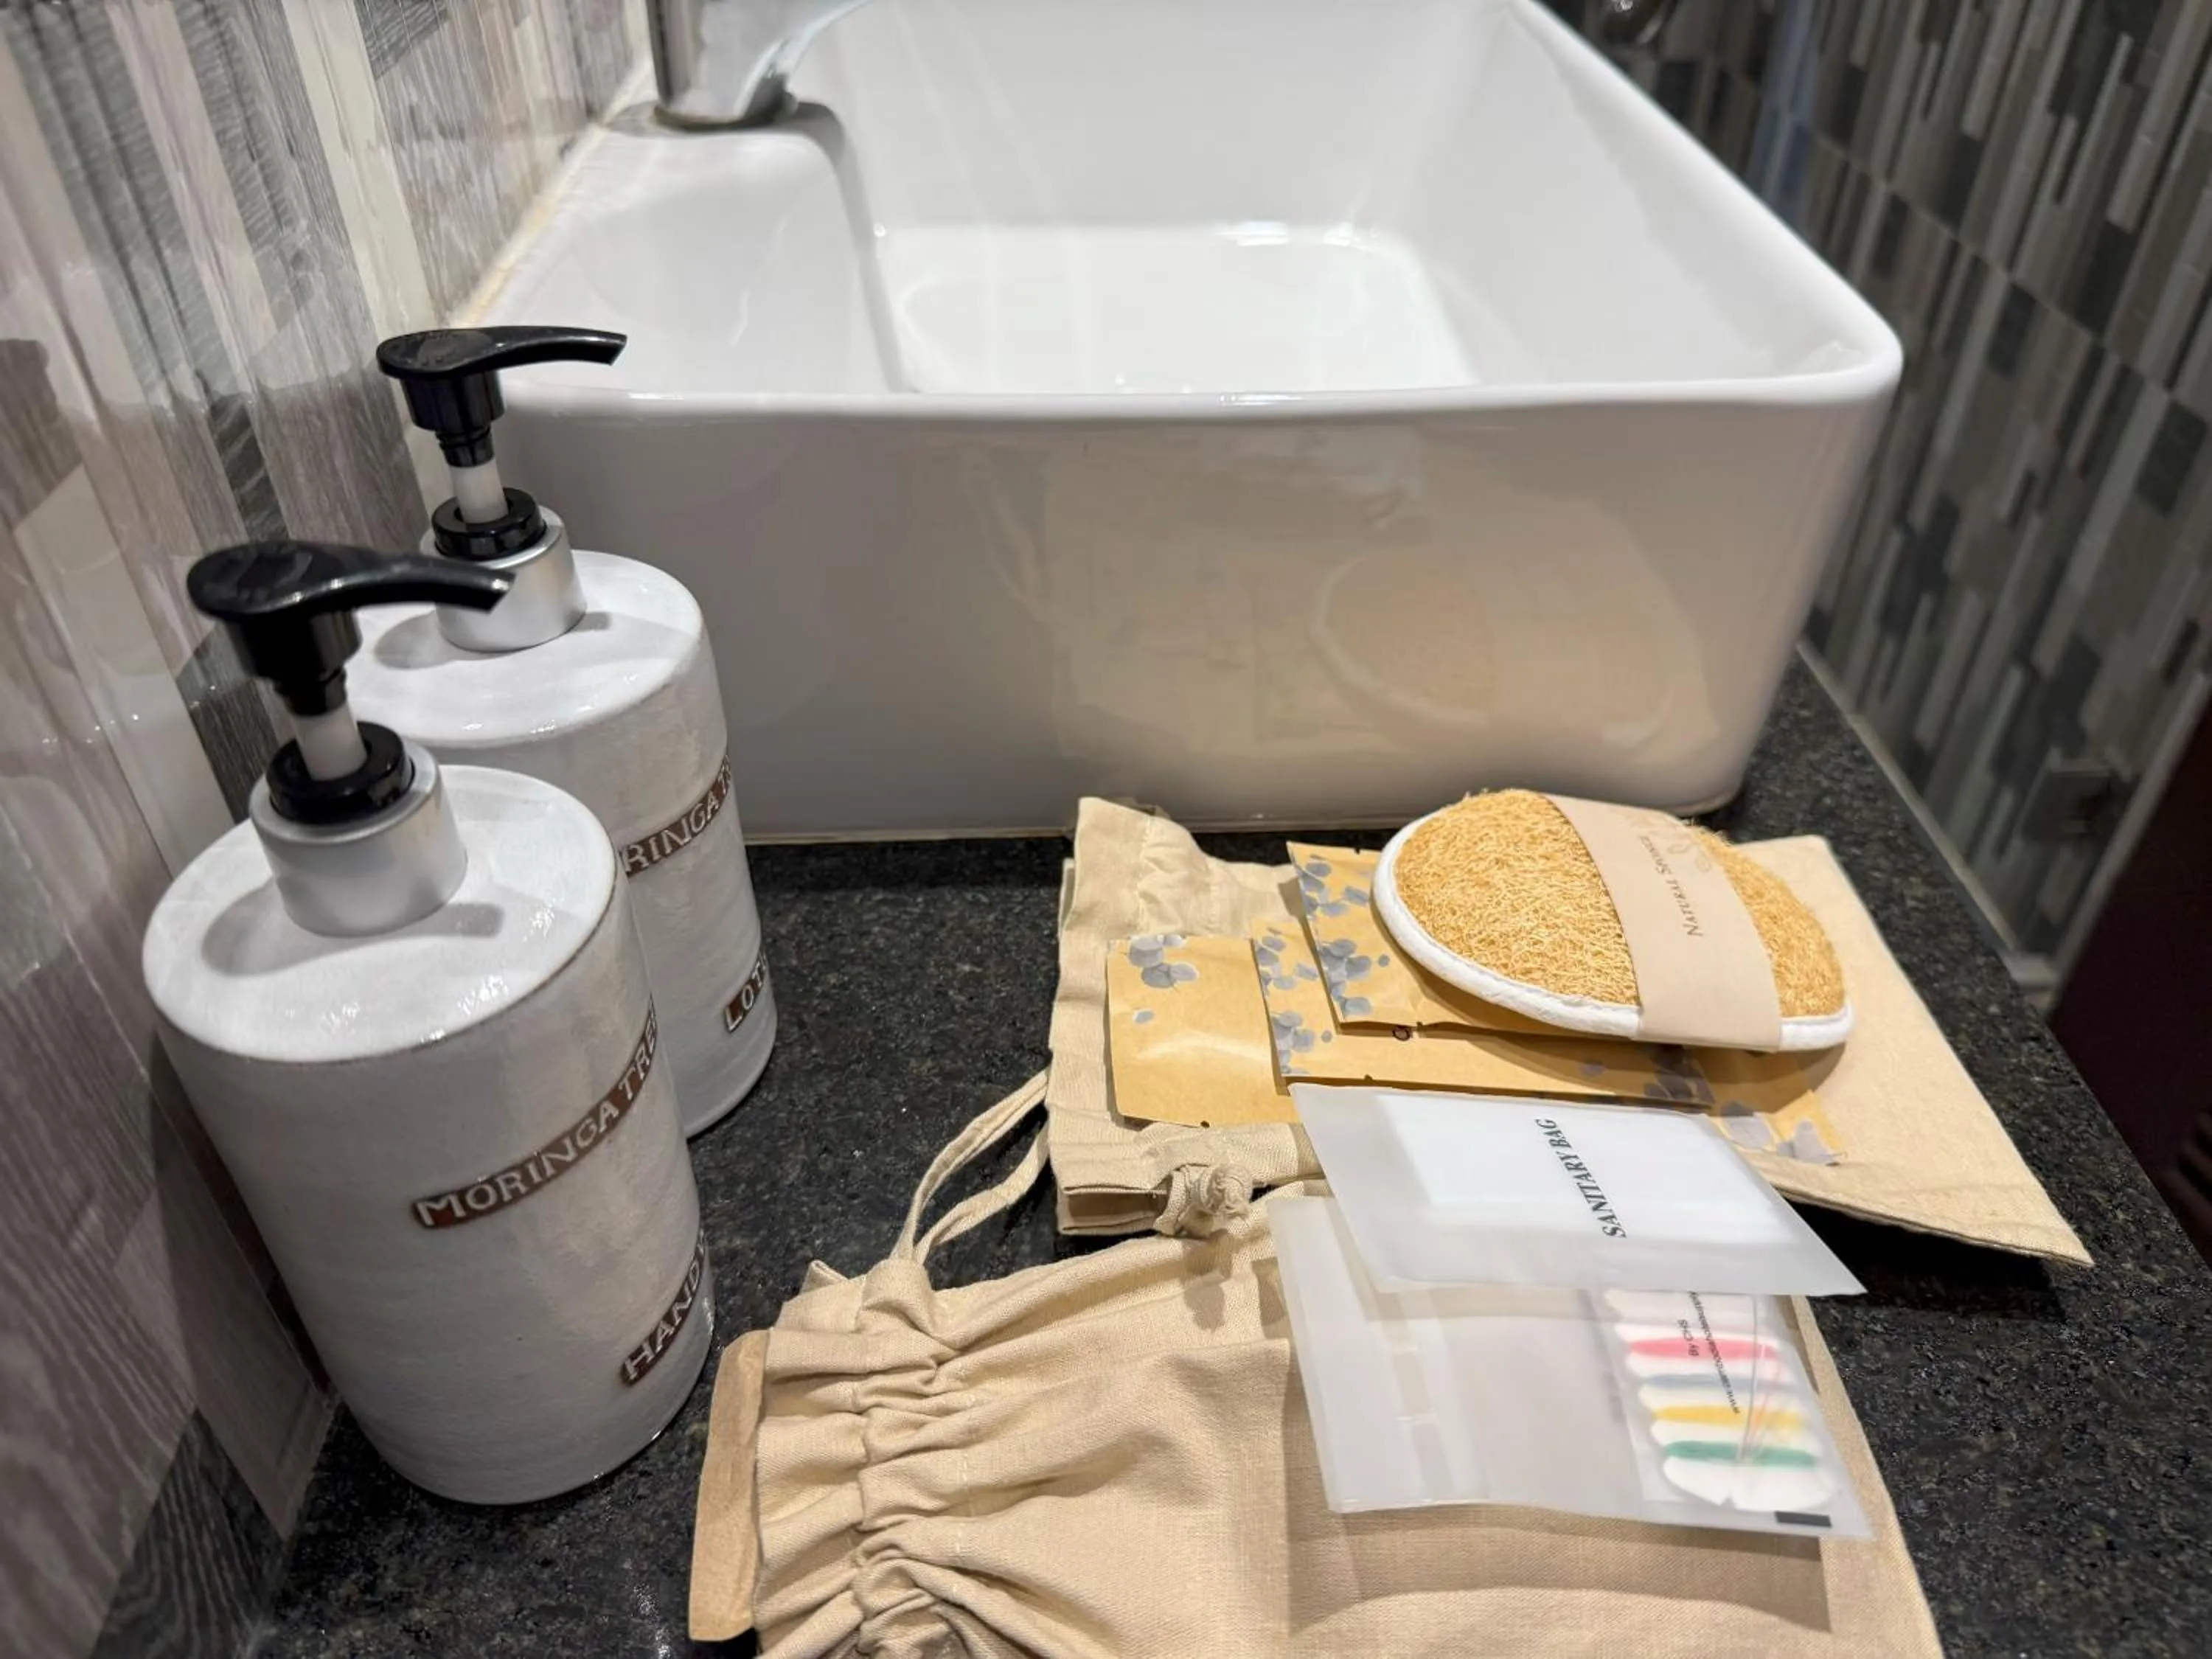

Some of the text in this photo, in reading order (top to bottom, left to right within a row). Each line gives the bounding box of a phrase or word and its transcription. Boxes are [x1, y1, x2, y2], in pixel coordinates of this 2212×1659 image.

[621, 790, 719, 872] RINGA
[415, 1100, 619, 1227] MORINGA
[1534, 1118, 1627, 1239] SANITARY BAG
[625, 1260, 700, 1380] HAND
